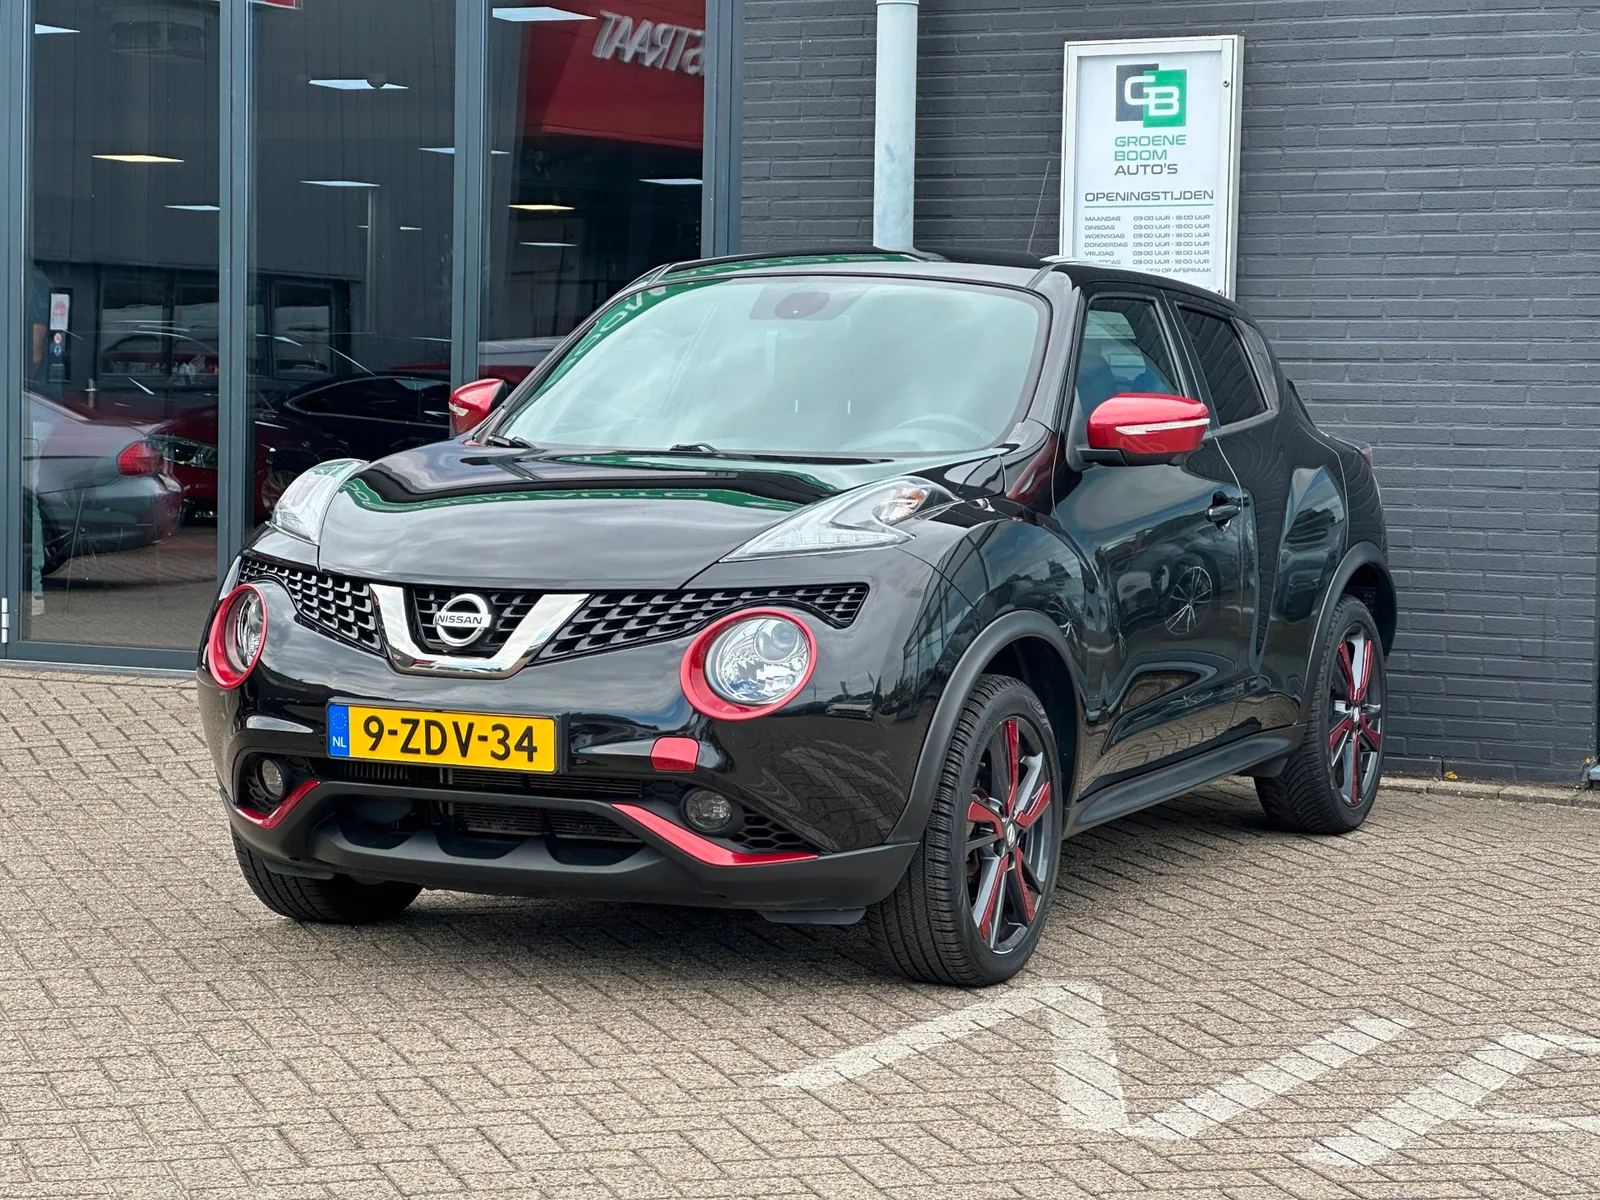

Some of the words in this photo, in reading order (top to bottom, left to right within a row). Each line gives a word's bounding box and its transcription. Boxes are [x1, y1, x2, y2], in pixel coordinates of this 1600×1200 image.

[1114, 134, 1187, 147] GROENE
[1114, 149, 1168, 161] BOOM
[1114, 163, 1178, 176] AUTO'S
[1084, 190, 1214, 202] OPENINGSTIJDEN
[437, 615, 482, 625] NISSAN
[332, 736, 347, 748] NL
[363, 715, 537, 762] 9-ZDV-34
